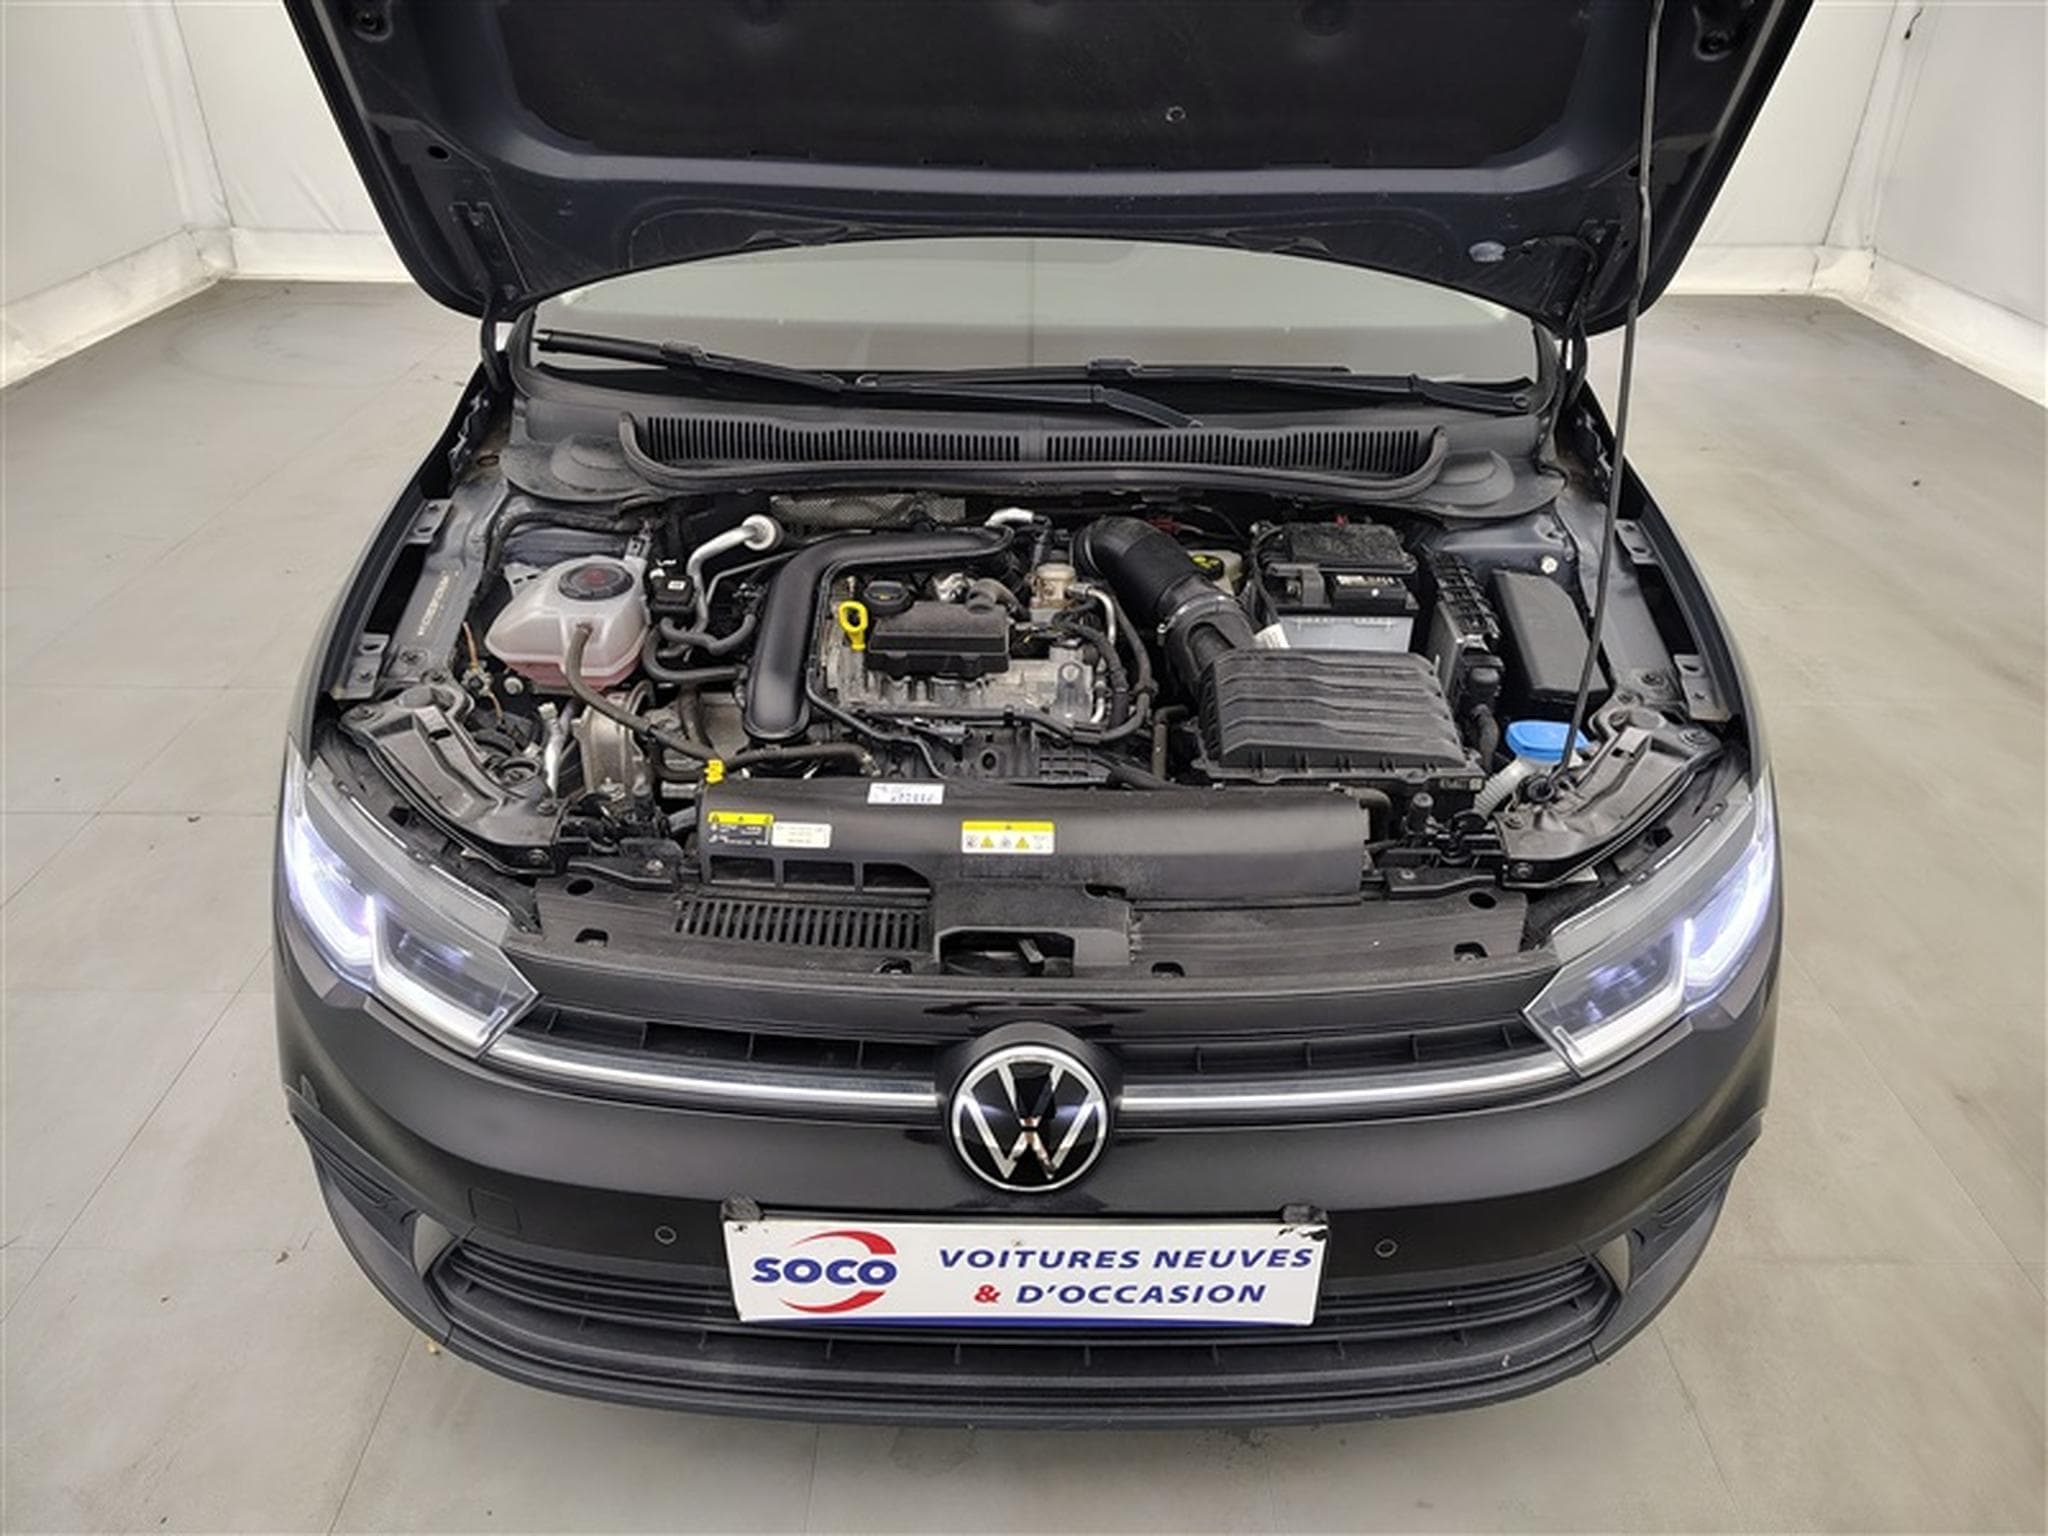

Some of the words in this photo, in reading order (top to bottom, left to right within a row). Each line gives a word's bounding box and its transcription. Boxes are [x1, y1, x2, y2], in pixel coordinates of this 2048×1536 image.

[939, 1249, 1140, 1268] VOITURES
[1153, 1249, 1313, 1268] NEUVES
[751, 1257, 897, 1285] SOCO
[974, 1284, 1001, 1304] &
[1016, 1284, 1266, 1304] D'OCCASION
